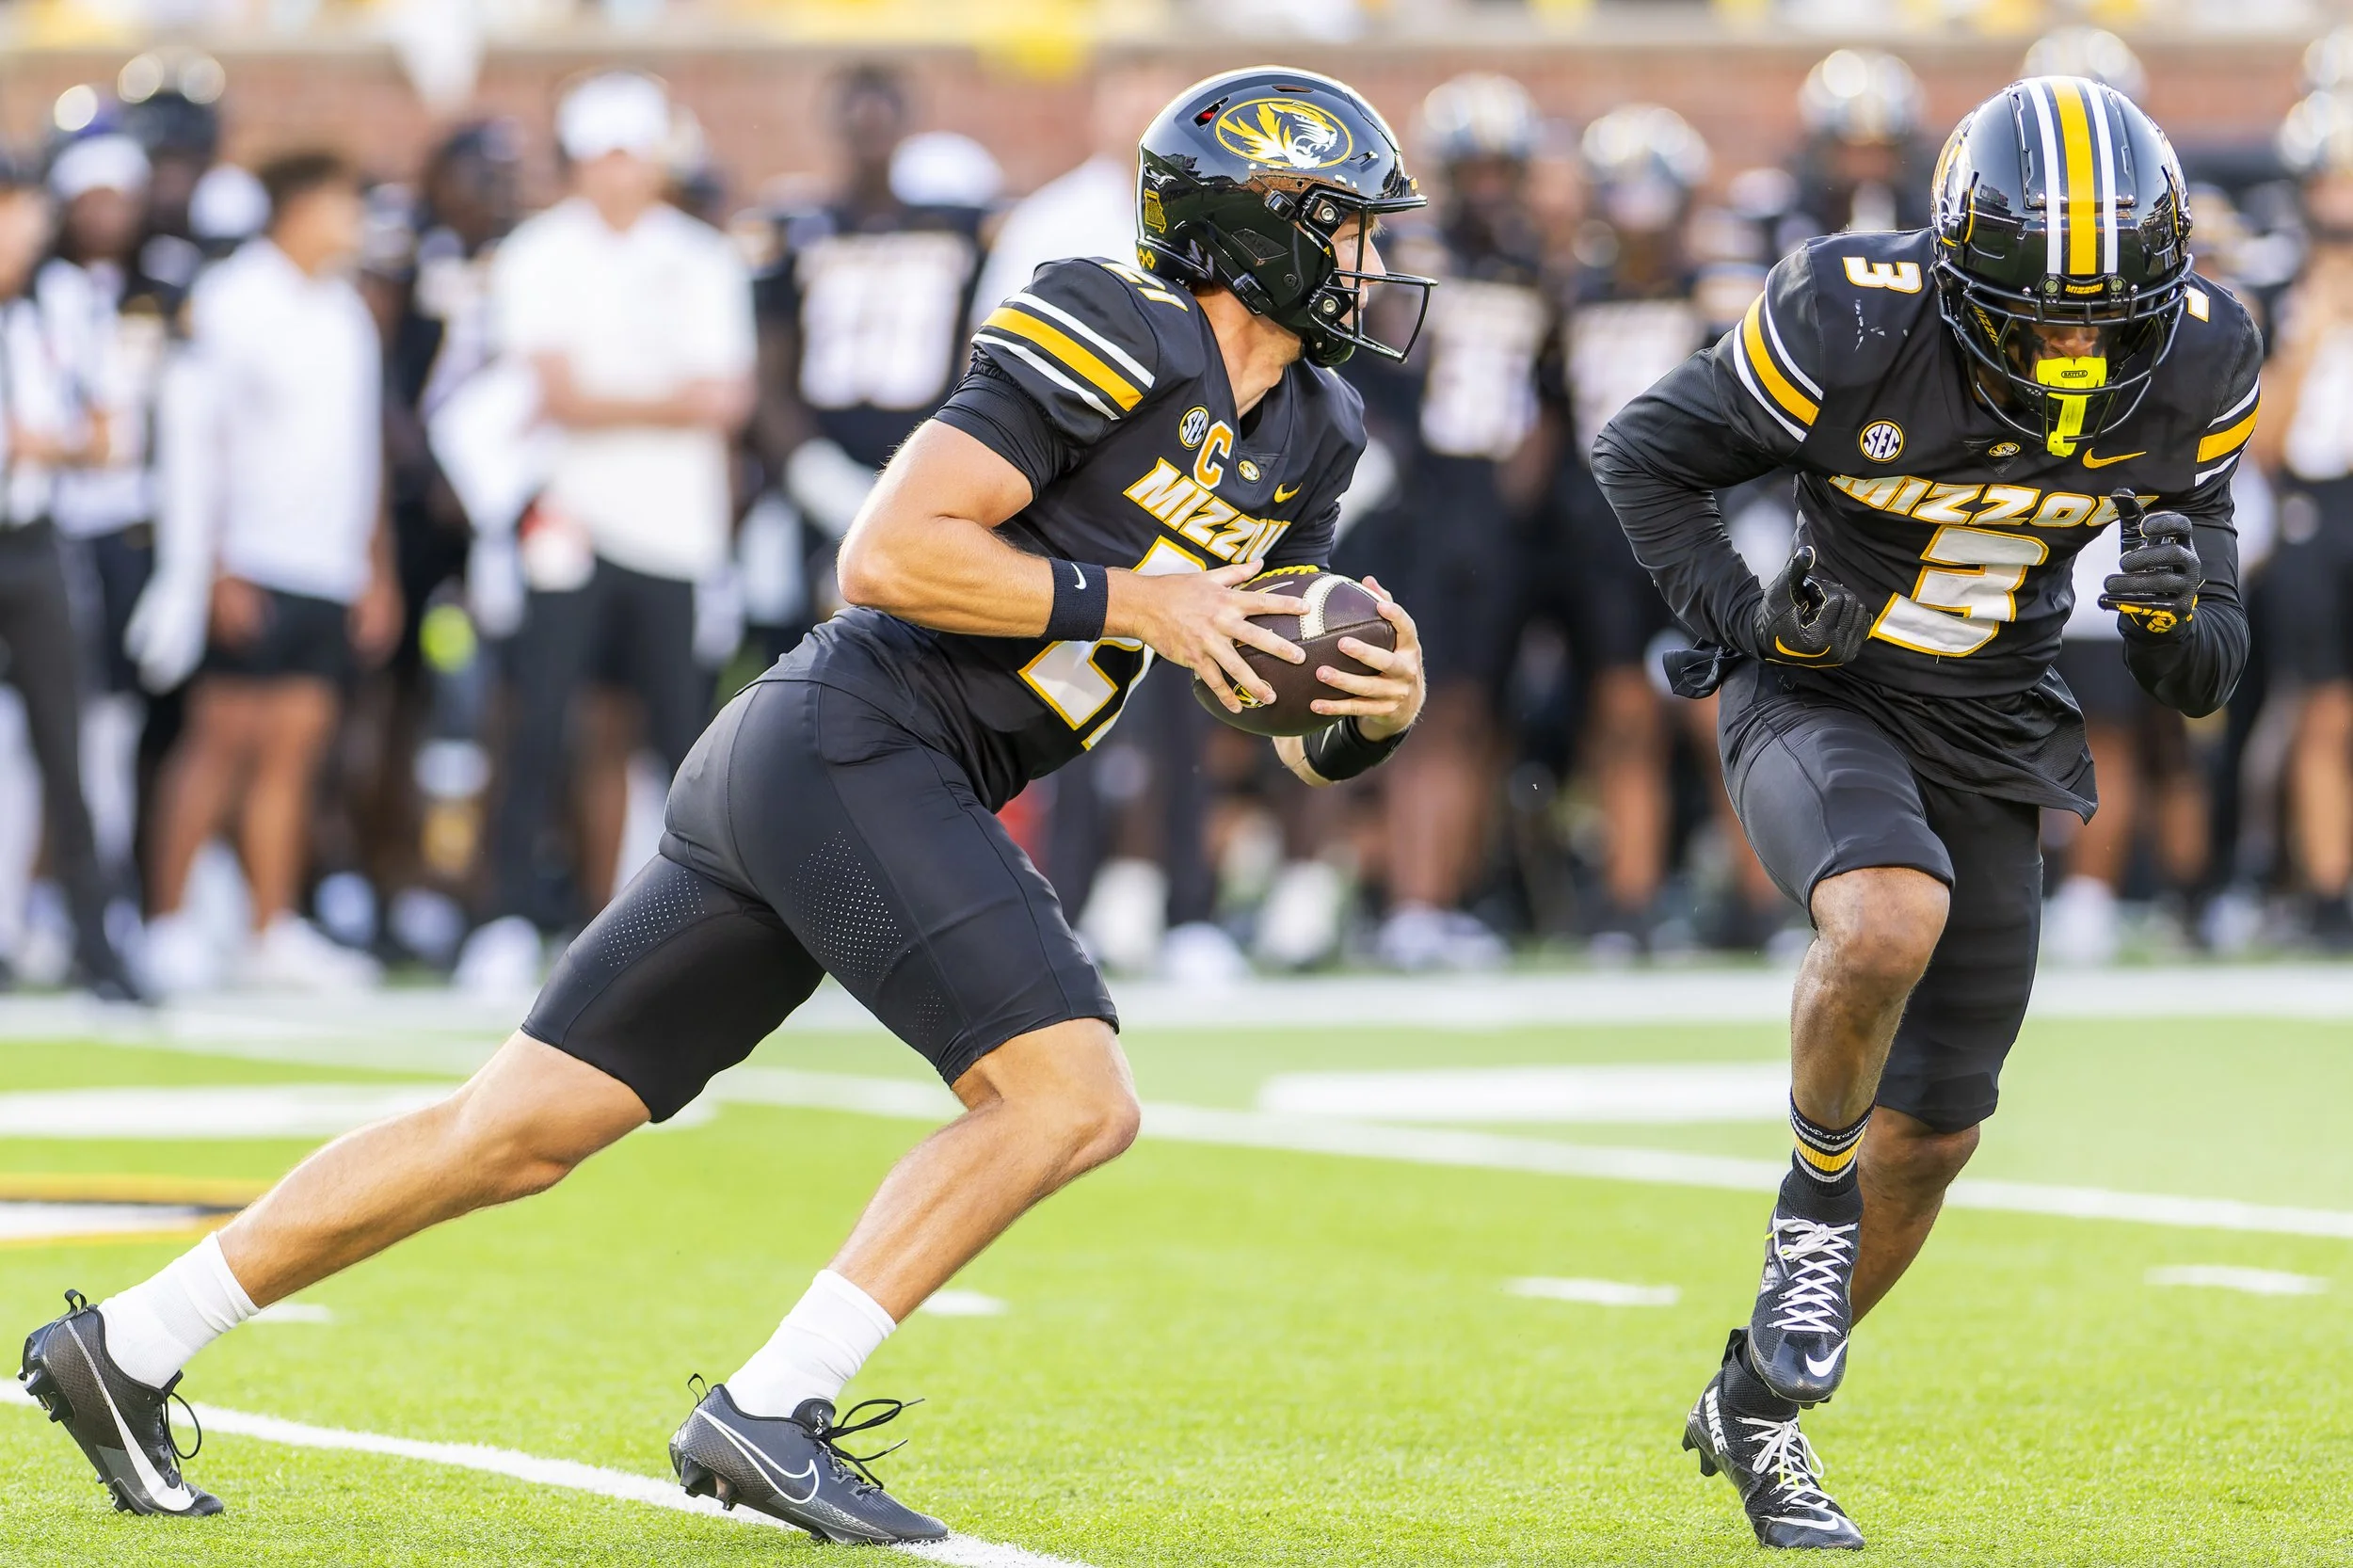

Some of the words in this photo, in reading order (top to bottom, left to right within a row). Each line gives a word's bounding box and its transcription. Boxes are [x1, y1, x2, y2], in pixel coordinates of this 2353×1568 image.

[1842, 256, 1923, 295] 3
[2065, 282, 2105, 295] MIZZOU
[1972, 304, 1999, 346] MIZZO
[1182, 410, 1208, 445] SEC
[1864, 424, 1900, 459] SEC
[1193, 420, 1235, 490] C
[1867, 524, 2050, 658] 3
[1705, 1385, 1730, 1456] NIKE
